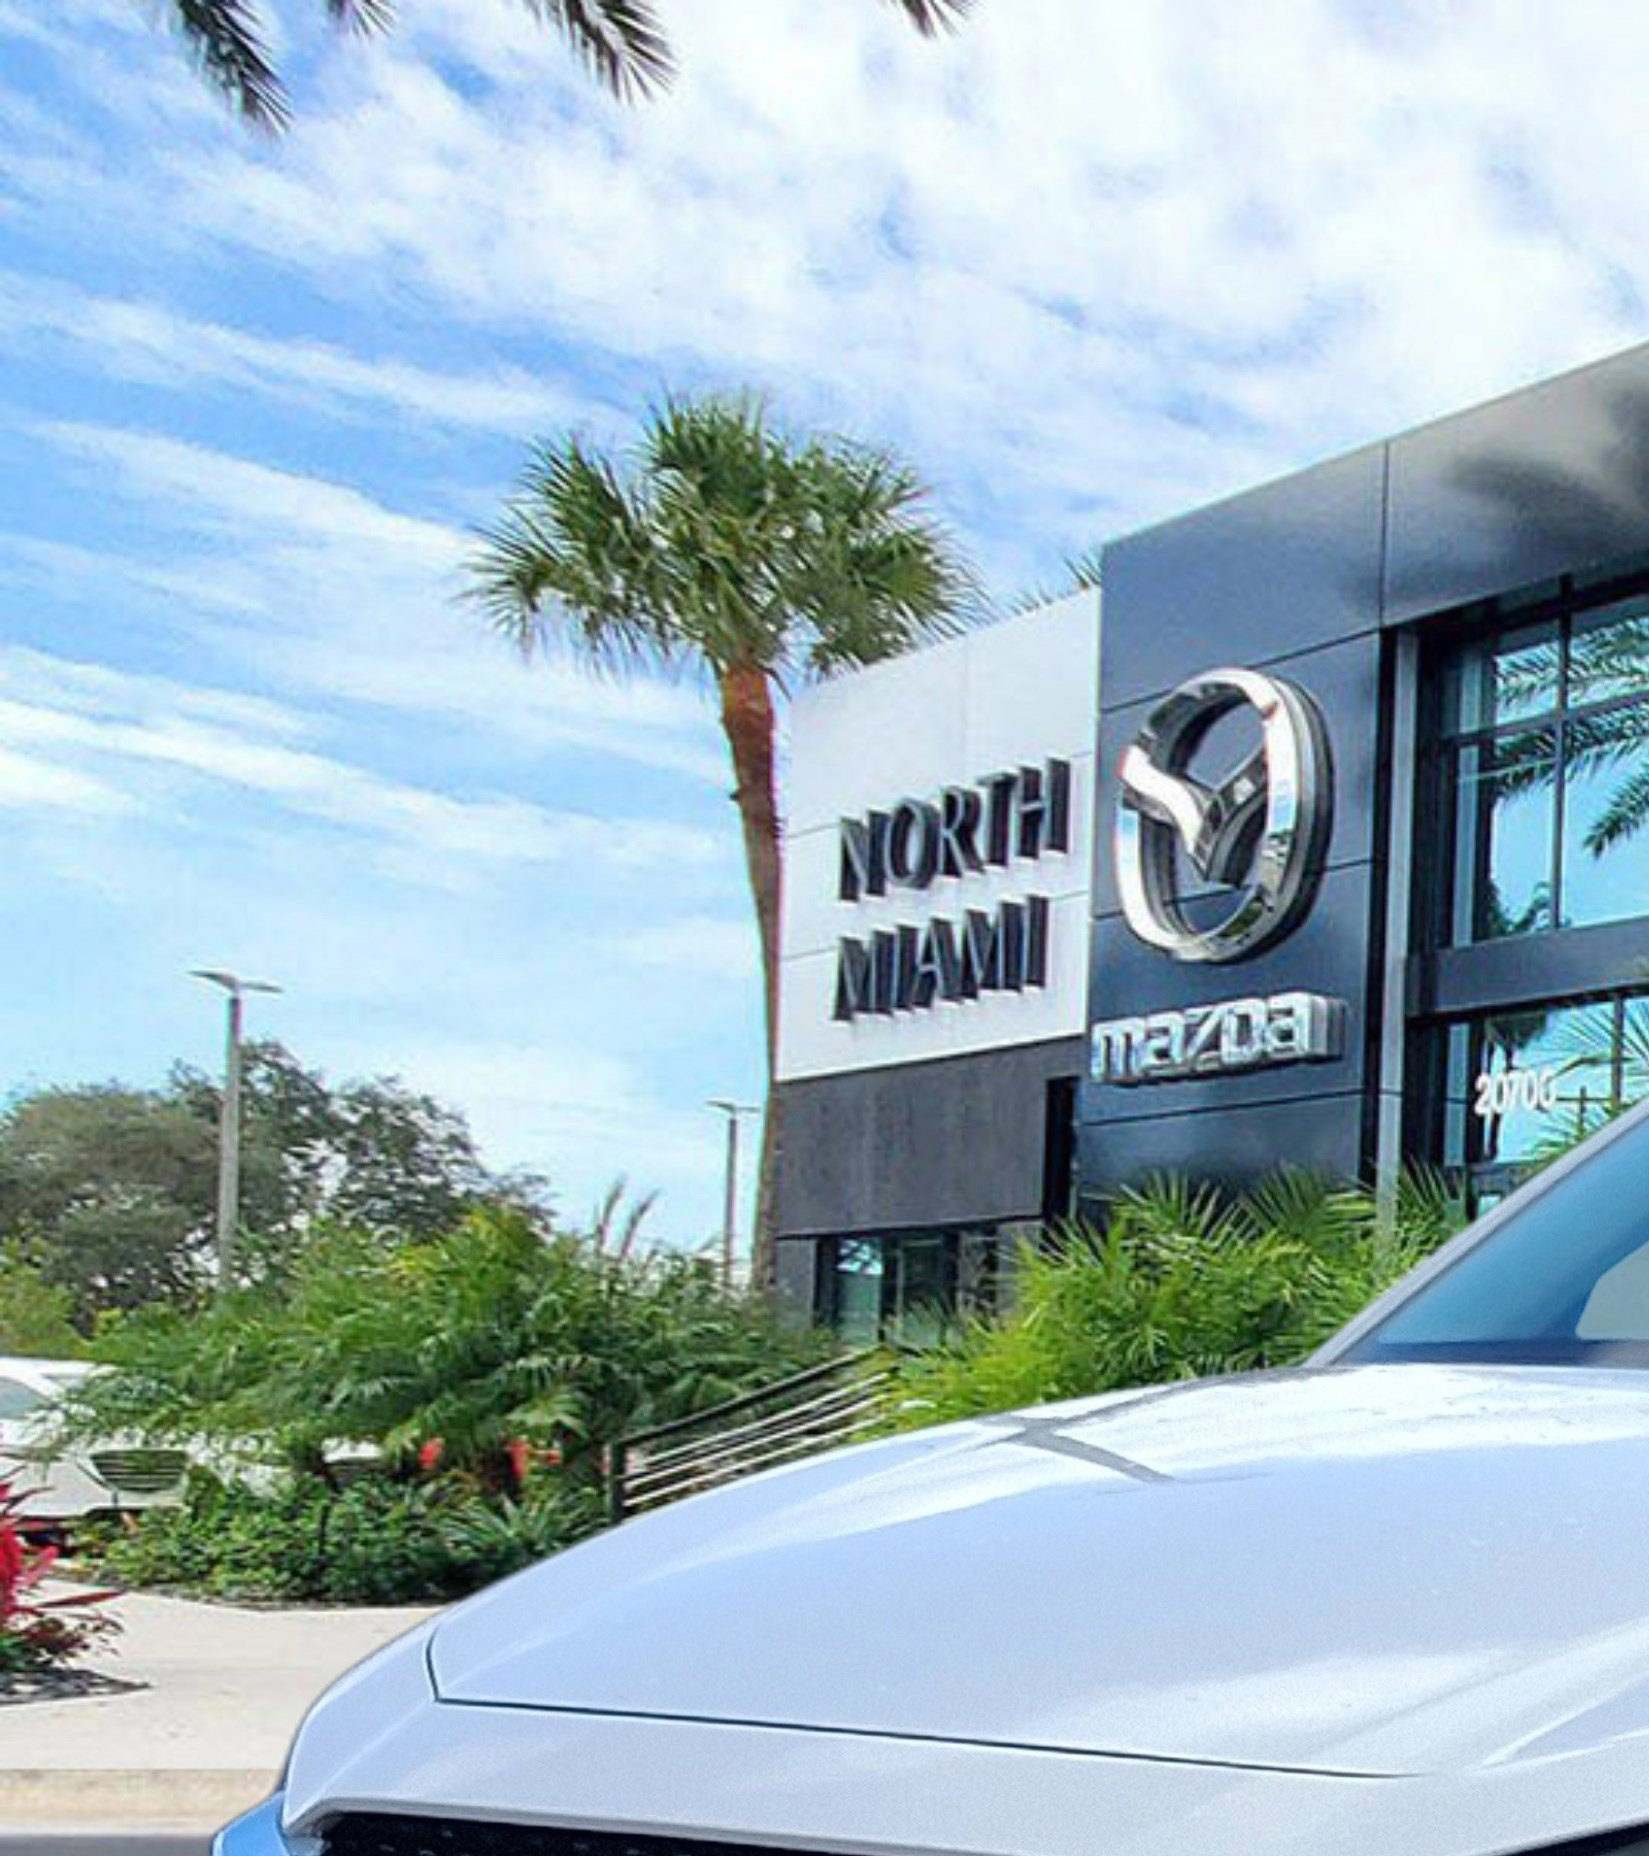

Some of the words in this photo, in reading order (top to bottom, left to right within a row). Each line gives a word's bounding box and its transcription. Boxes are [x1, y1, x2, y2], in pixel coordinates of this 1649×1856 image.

[838, 756, 1071, 902] NORTH
[832, 894, 1050, 1021] MIAMI
[1474, 1068, 1557, 1116] 20700
